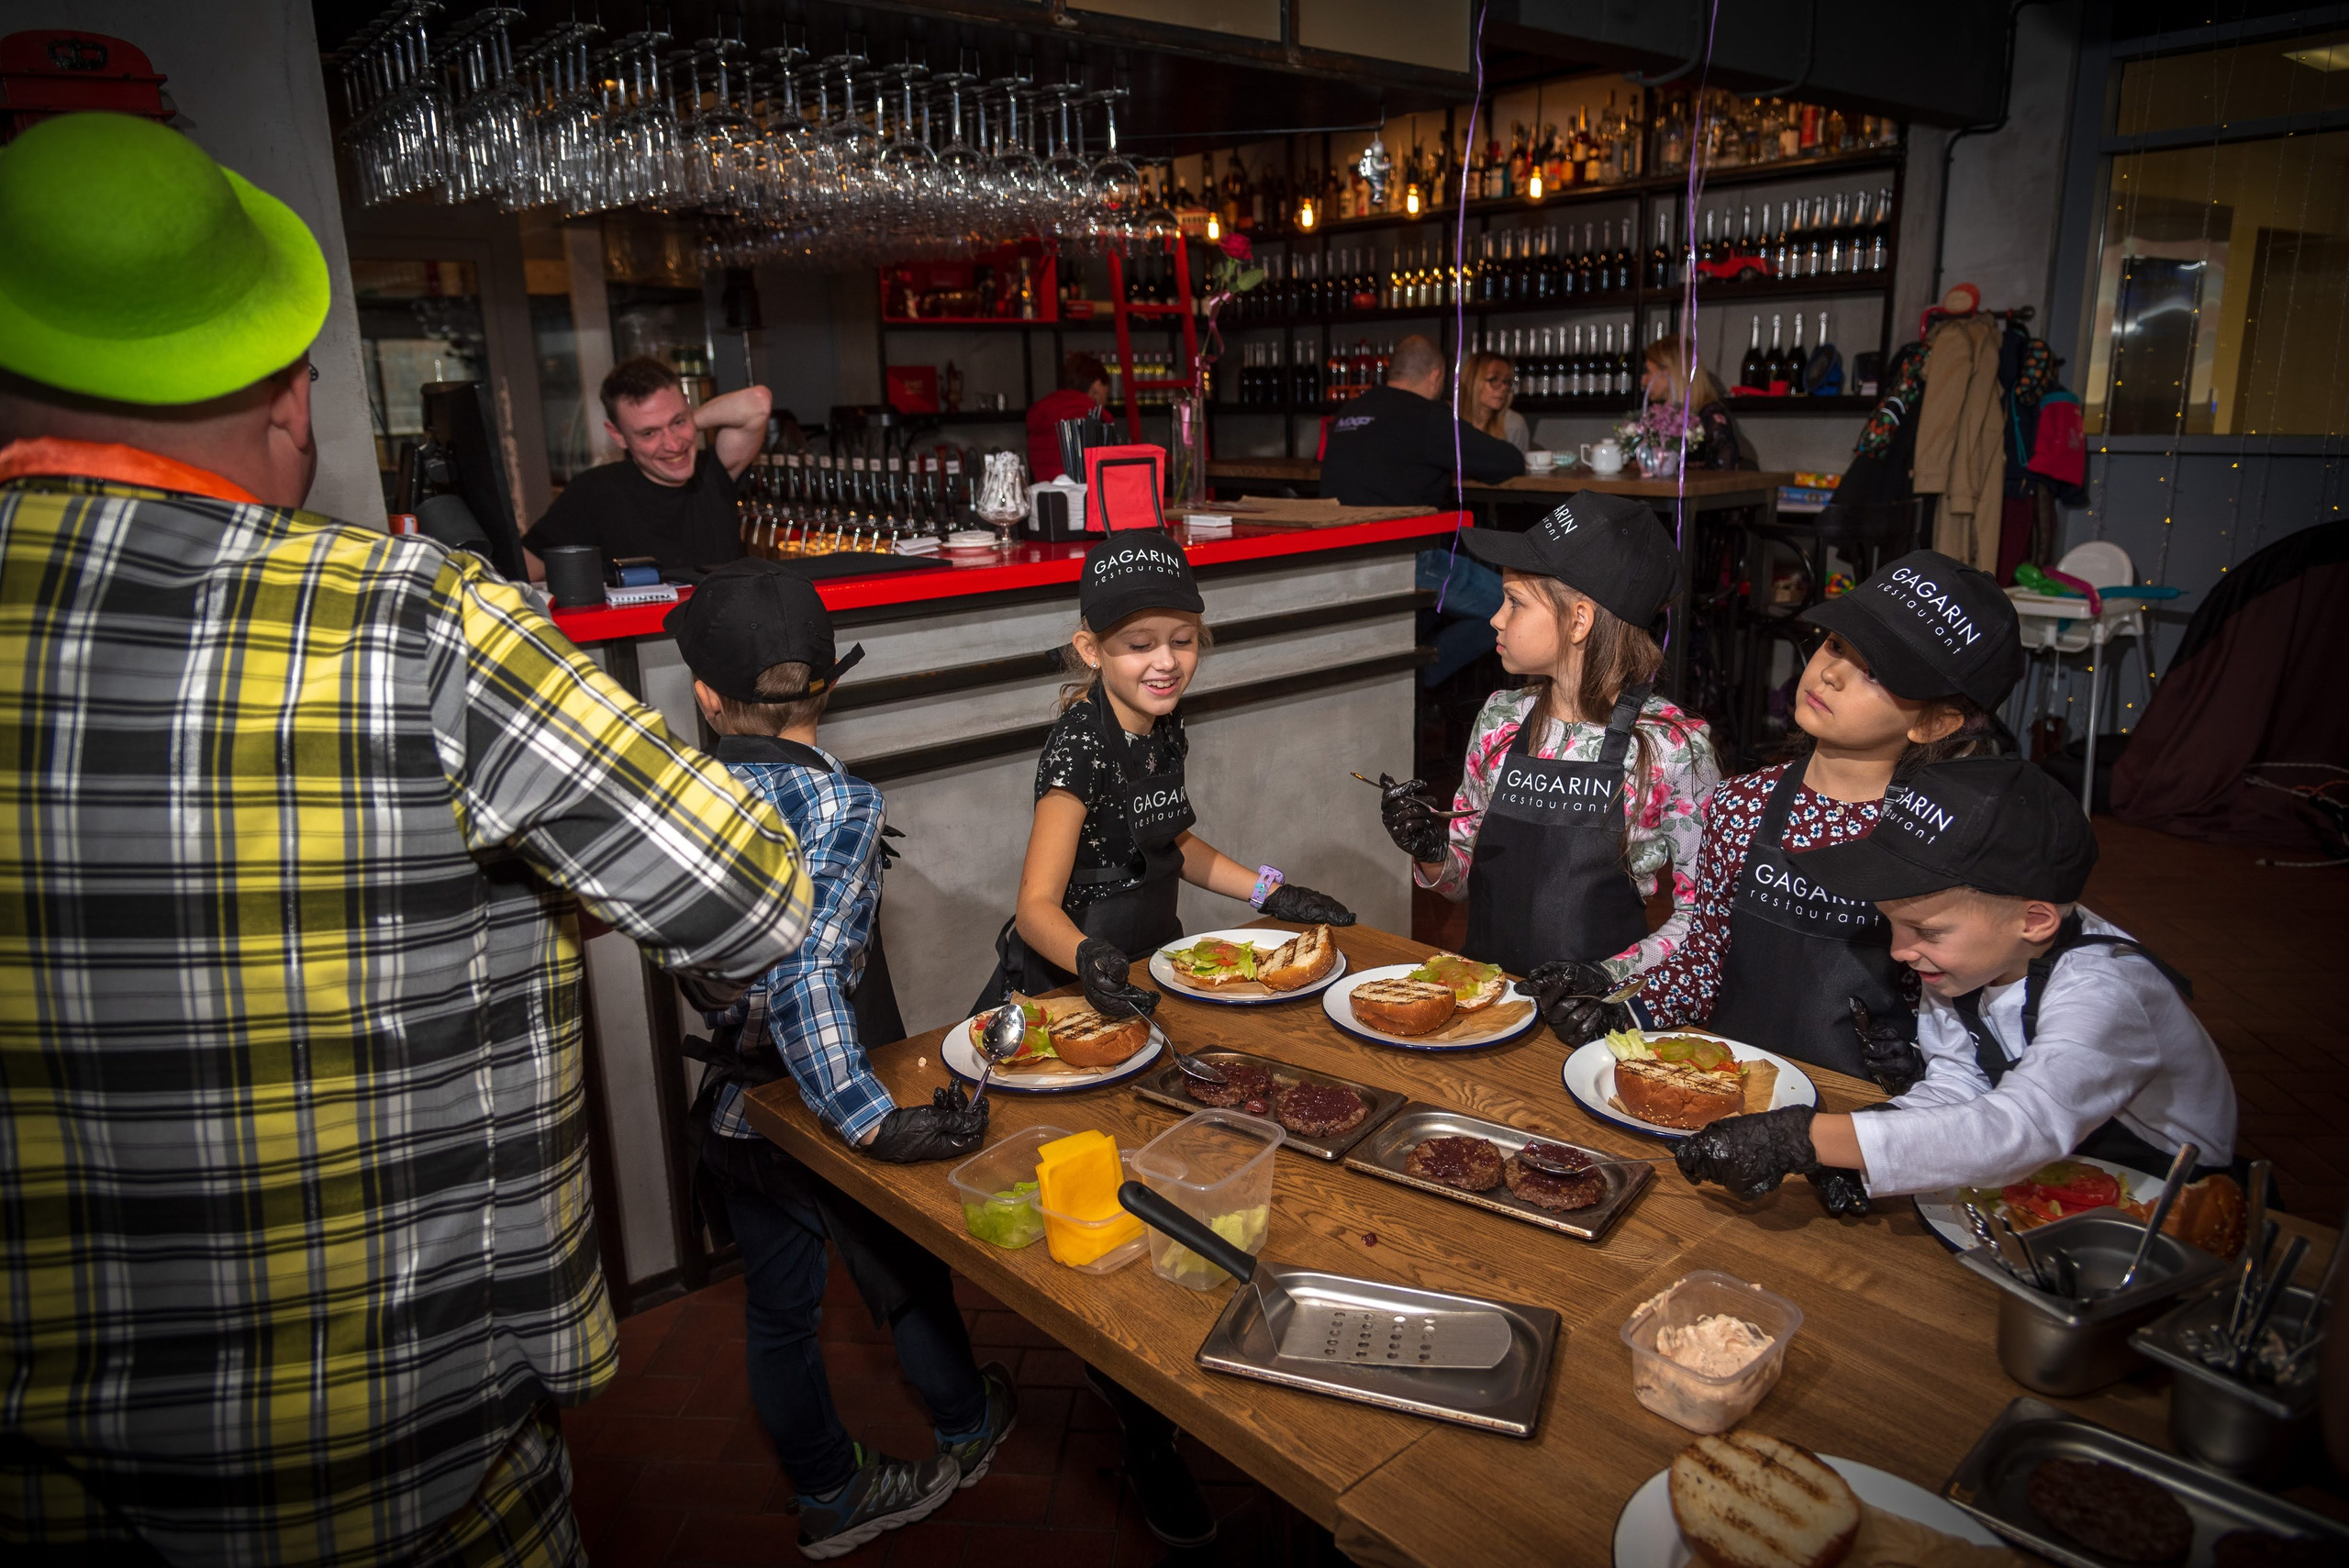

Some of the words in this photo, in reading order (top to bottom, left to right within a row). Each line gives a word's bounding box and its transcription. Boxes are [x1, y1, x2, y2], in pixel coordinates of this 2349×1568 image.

[1094, 548, 1180, 575] GAGARIN
[1094, 565, 1181, 587] restaurant
[1876, 582, 1963, 655] restaurant
[1891, 567, 1981, 646] GAGARIN
[1507, 770, 1611, 798] GAGARIN
[1133, 785, 1187, 814] GAGAR
[1501, 793, 1609, 814] restaurant
[1134, 804, 1190, 829] restaura
[1754, 863, 1866, 906] GAGA
[1750, 889, 1880, 927] restaurant
